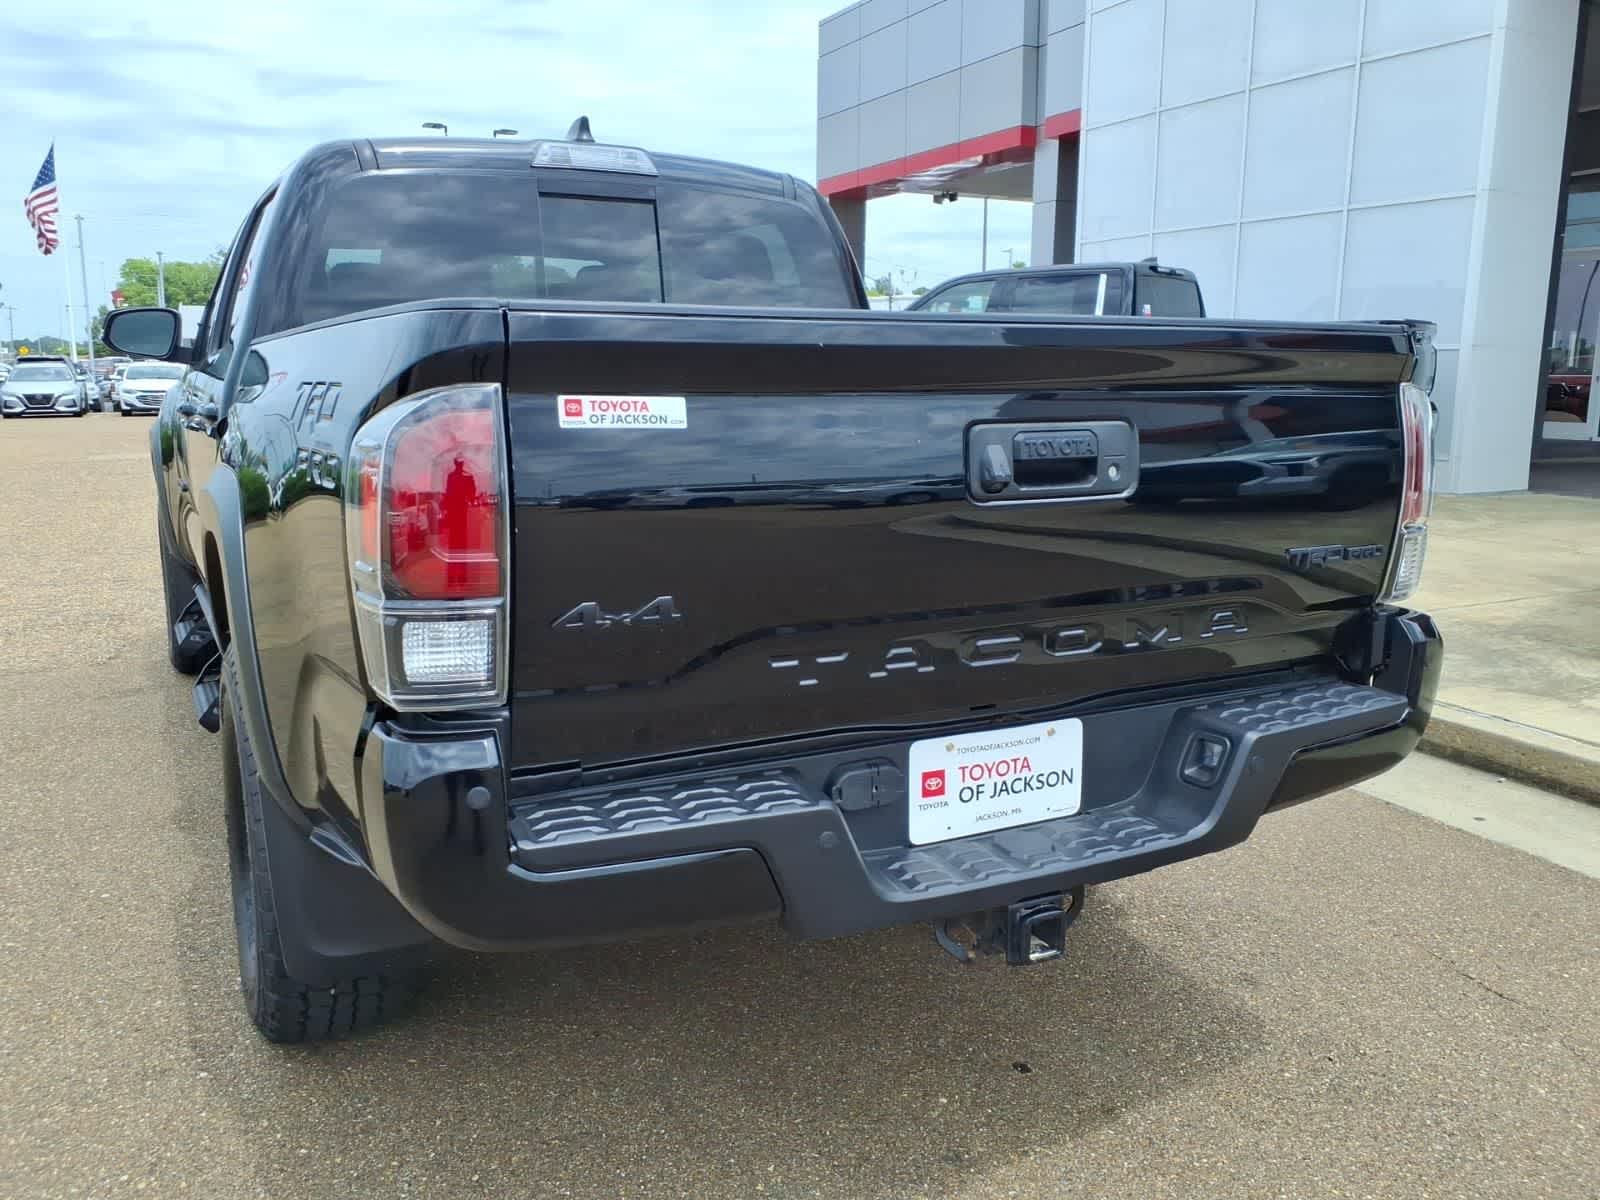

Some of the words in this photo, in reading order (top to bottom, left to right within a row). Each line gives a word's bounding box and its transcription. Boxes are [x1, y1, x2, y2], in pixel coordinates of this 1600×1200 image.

[588, 400, 649, 412] TOYOTA
[589, 414, 607, 424] OF
[610, 414, 668, 425] JACKSON
[1024, 437, 1095, 457] TOYOTA
[1285, 545, 1344, 569] TRD
[767, 608, 1249, 685] TACOMA
[957, 736, 1041, 755] TOYOTAOFJACKSON.COM
[958, 756, 1032, 783] TOYOTA
[959, 784, 985, 803] OF
[990, 768, 1074, 799] JACKSON
[918, 800, 949, 811] TOYOTA
